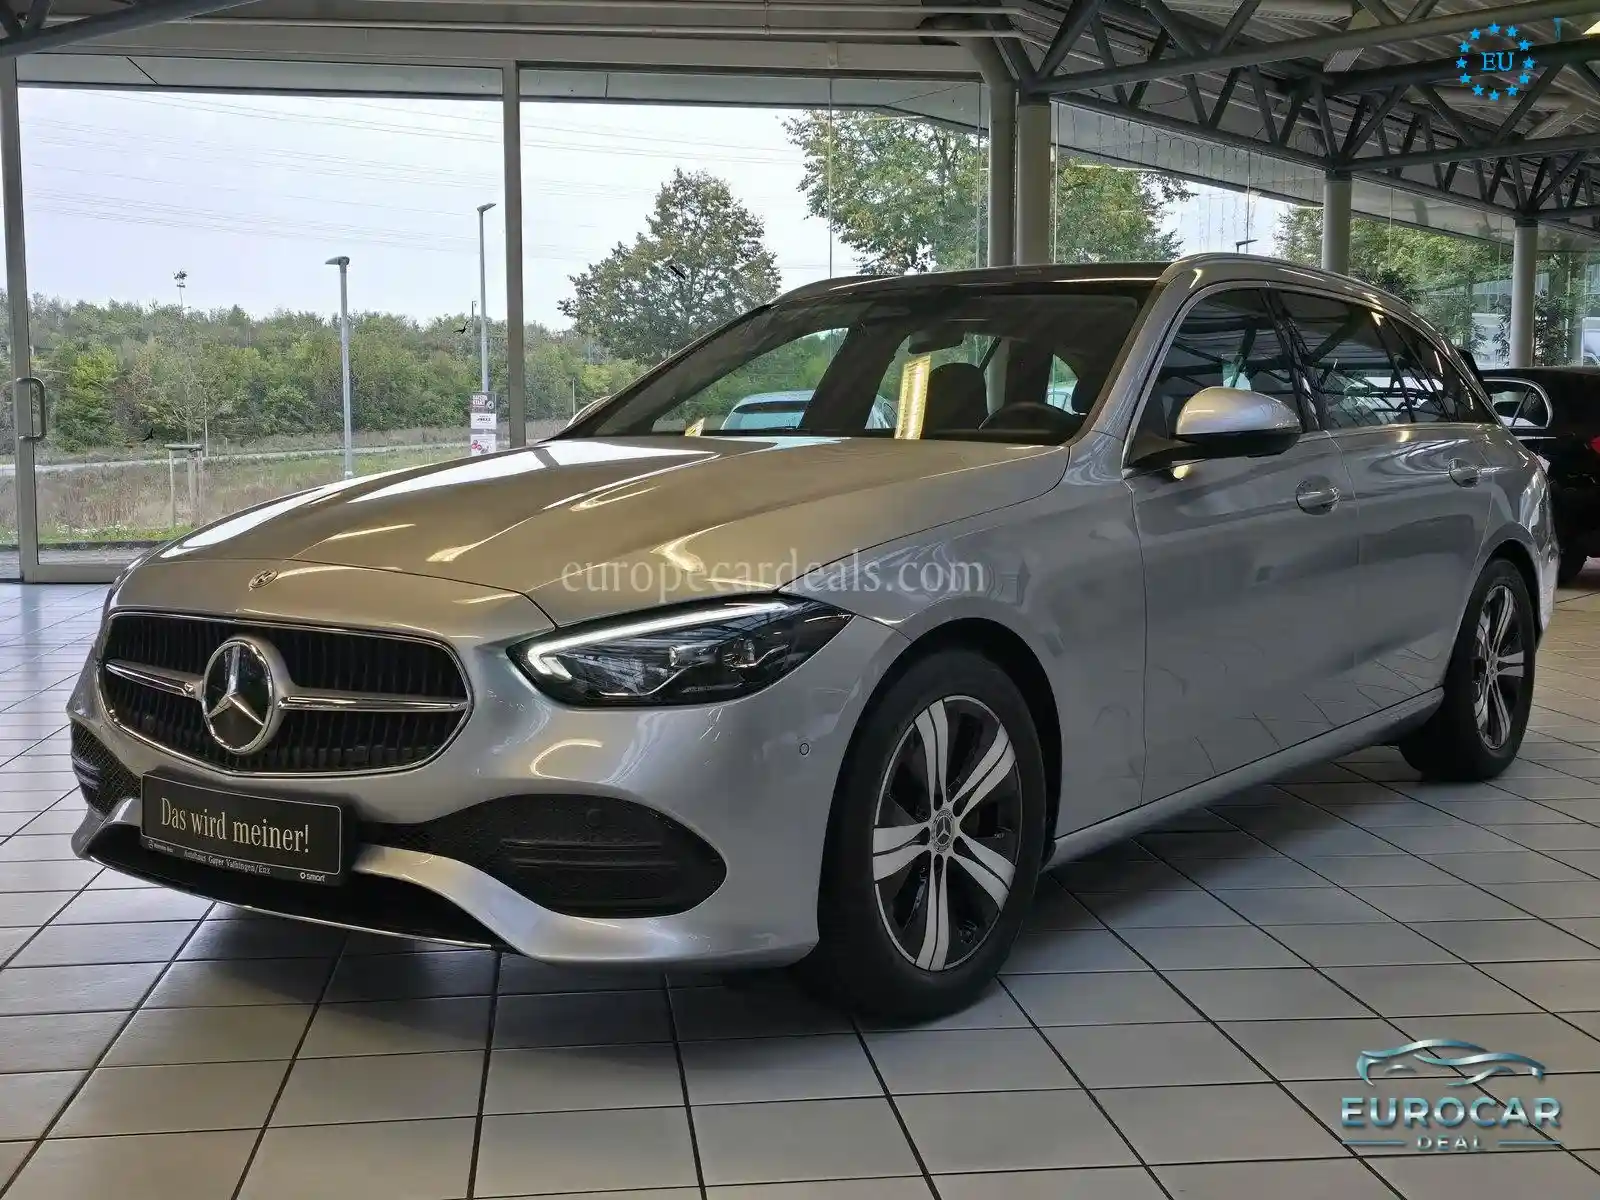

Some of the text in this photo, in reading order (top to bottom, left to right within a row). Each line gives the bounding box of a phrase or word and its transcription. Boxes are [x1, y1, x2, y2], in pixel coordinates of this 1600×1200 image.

[161, 797, 309, 854] Das wird meiner!
